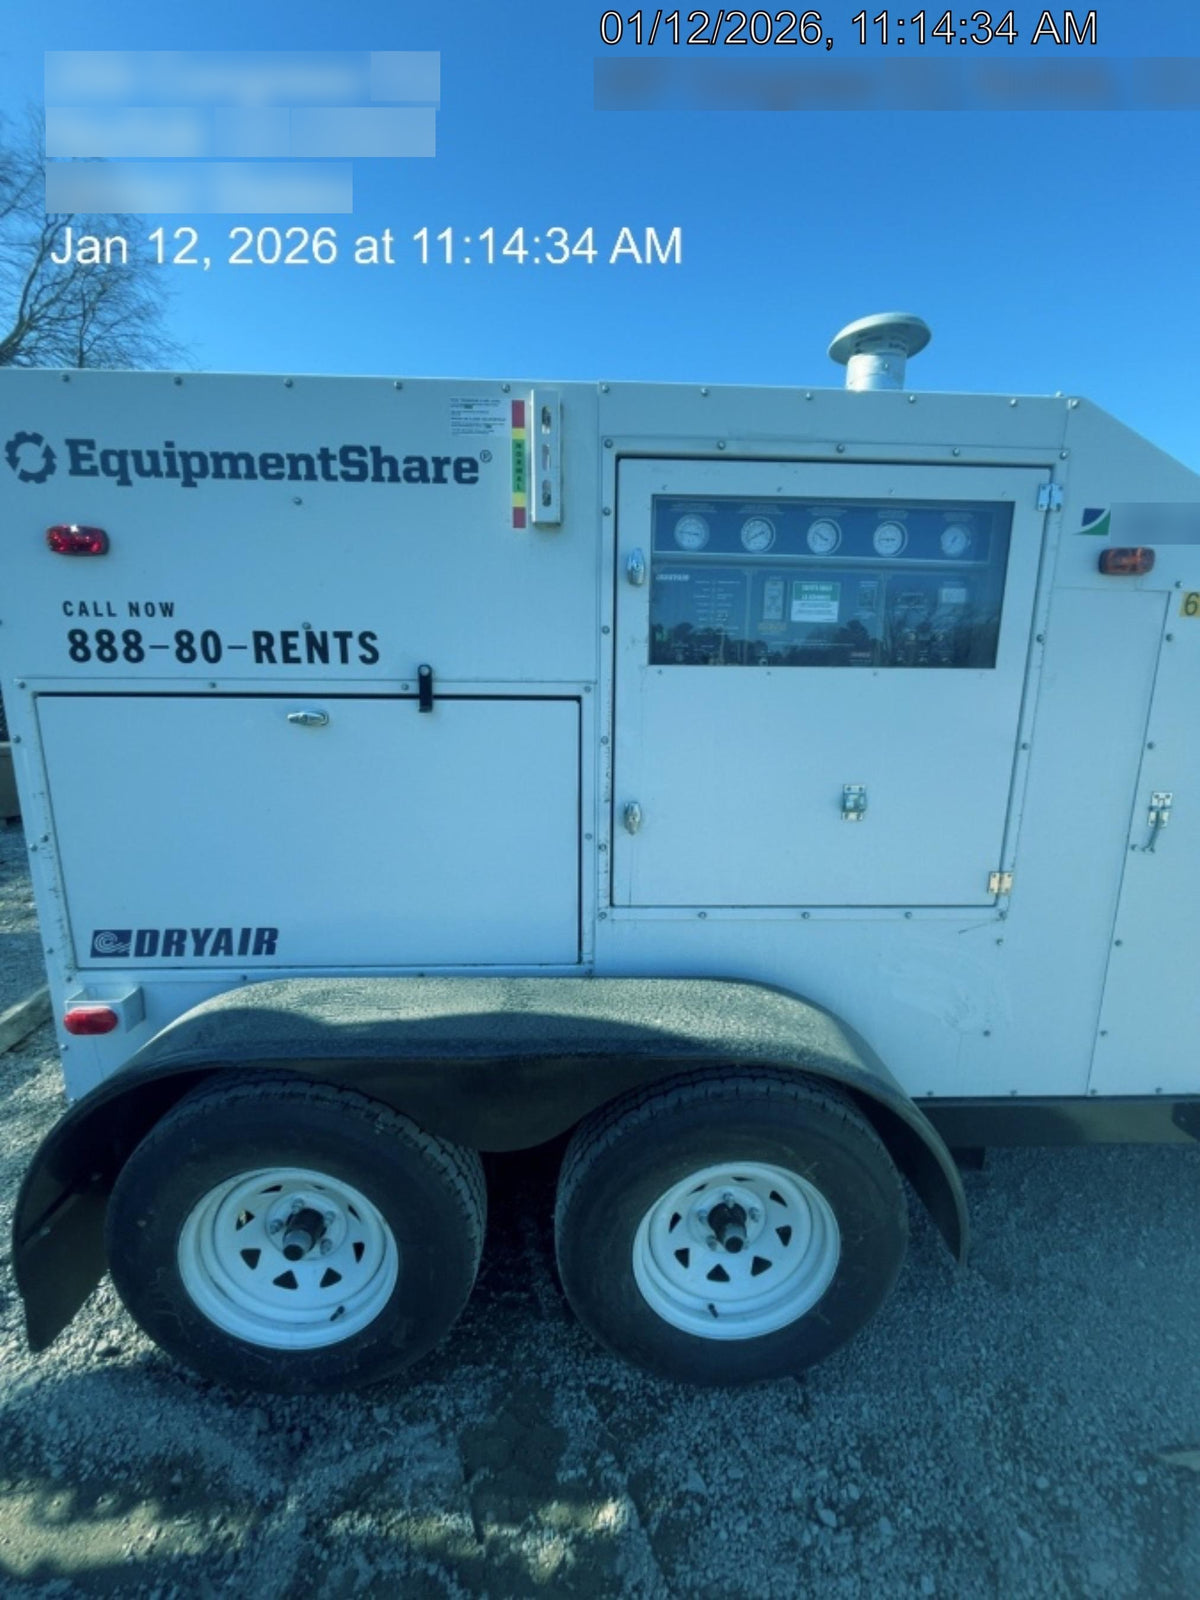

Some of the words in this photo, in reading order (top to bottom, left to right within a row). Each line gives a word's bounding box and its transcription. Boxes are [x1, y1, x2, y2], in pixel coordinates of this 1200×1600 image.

[515, 442, 523, 490] NORMAL
[63, 601, 118, 618] CALL
[129, 602, 176, 618] NOW
[68, 628, 381, 666] 888-80-RENTS
[134, 928, 280, 958] DRYAIR
